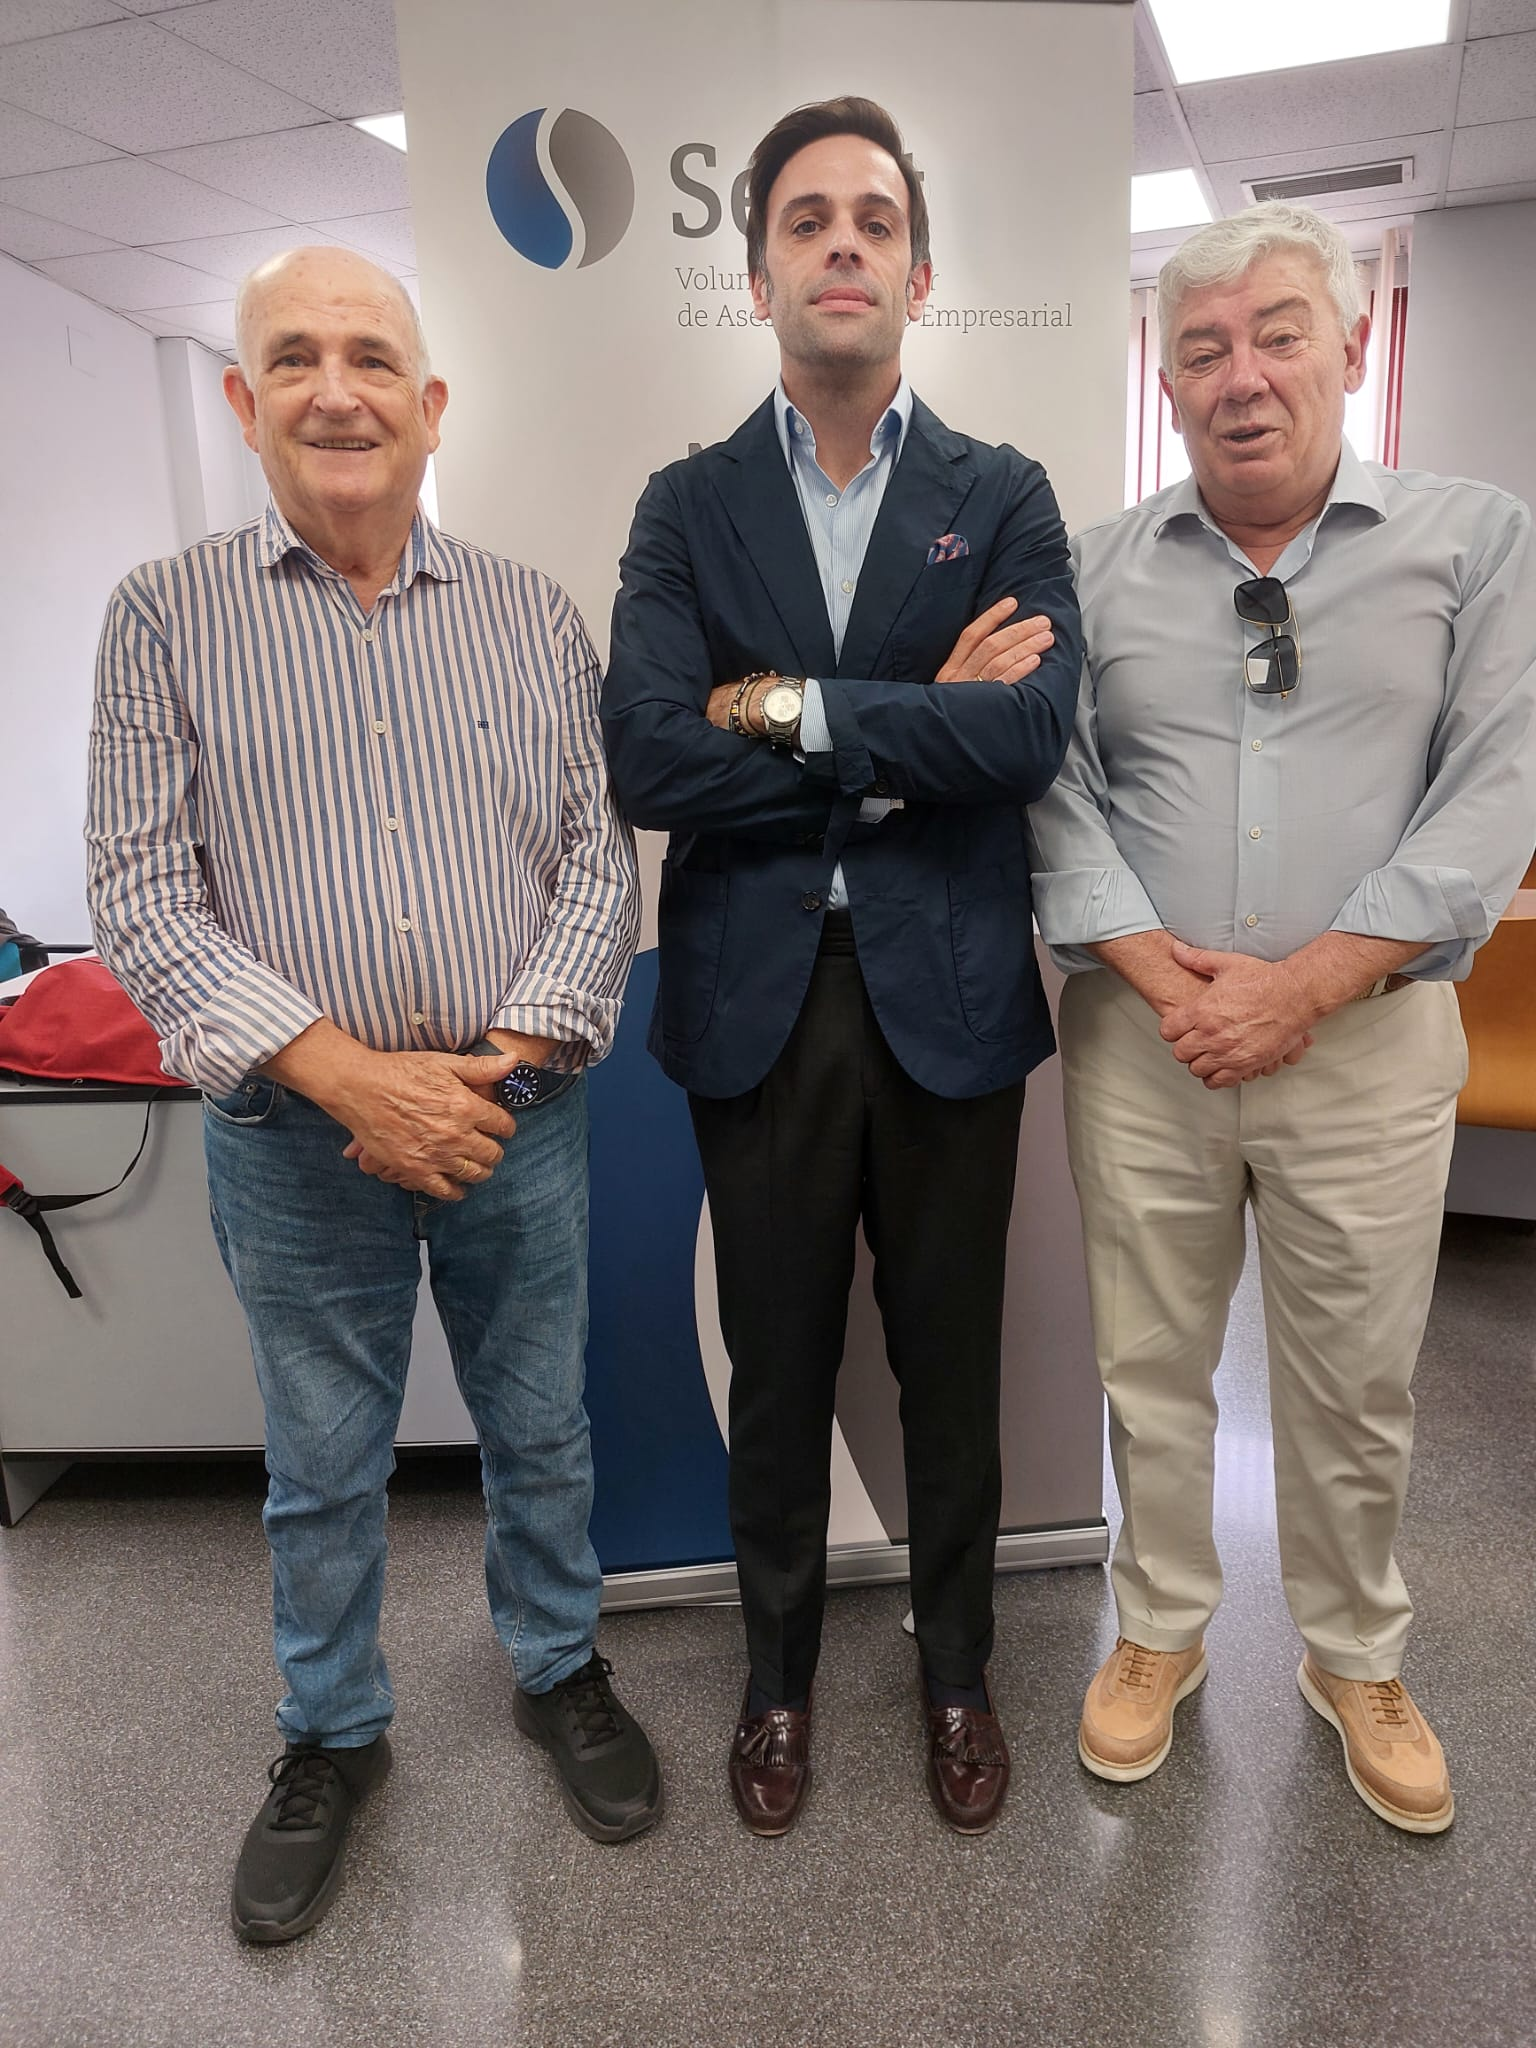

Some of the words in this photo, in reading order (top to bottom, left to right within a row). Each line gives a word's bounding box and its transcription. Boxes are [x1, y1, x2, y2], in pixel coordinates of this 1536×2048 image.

[675, 265, 751, 291] Volun
[678, 302, 708, 327] de
[920, 302, 1072, 334] Empresarial
